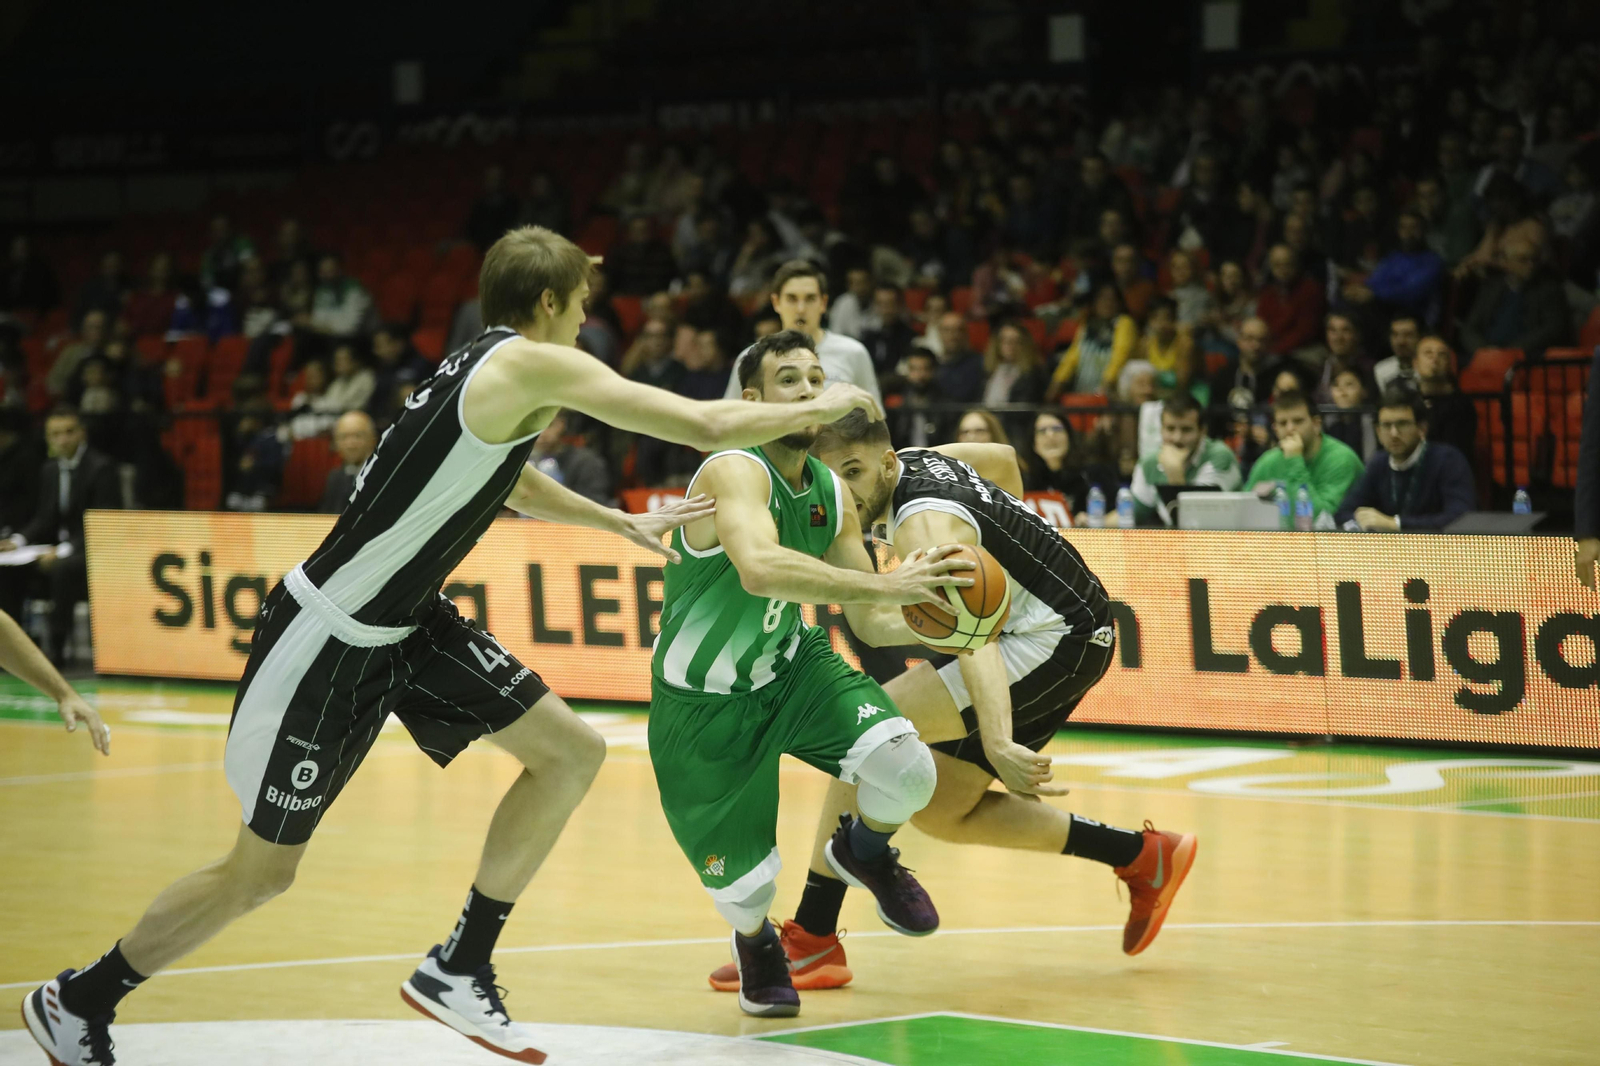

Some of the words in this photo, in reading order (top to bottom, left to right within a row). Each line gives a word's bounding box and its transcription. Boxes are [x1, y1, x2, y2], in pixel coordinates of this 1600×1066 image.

[763, 599, 787, 634] 8
[152, 551, 267, 654] Sig
[1188, 577, 1600, 715] LaLiga
[499, 685, 515, 697] EL
[265, 785, 322, 811] Bilbao
